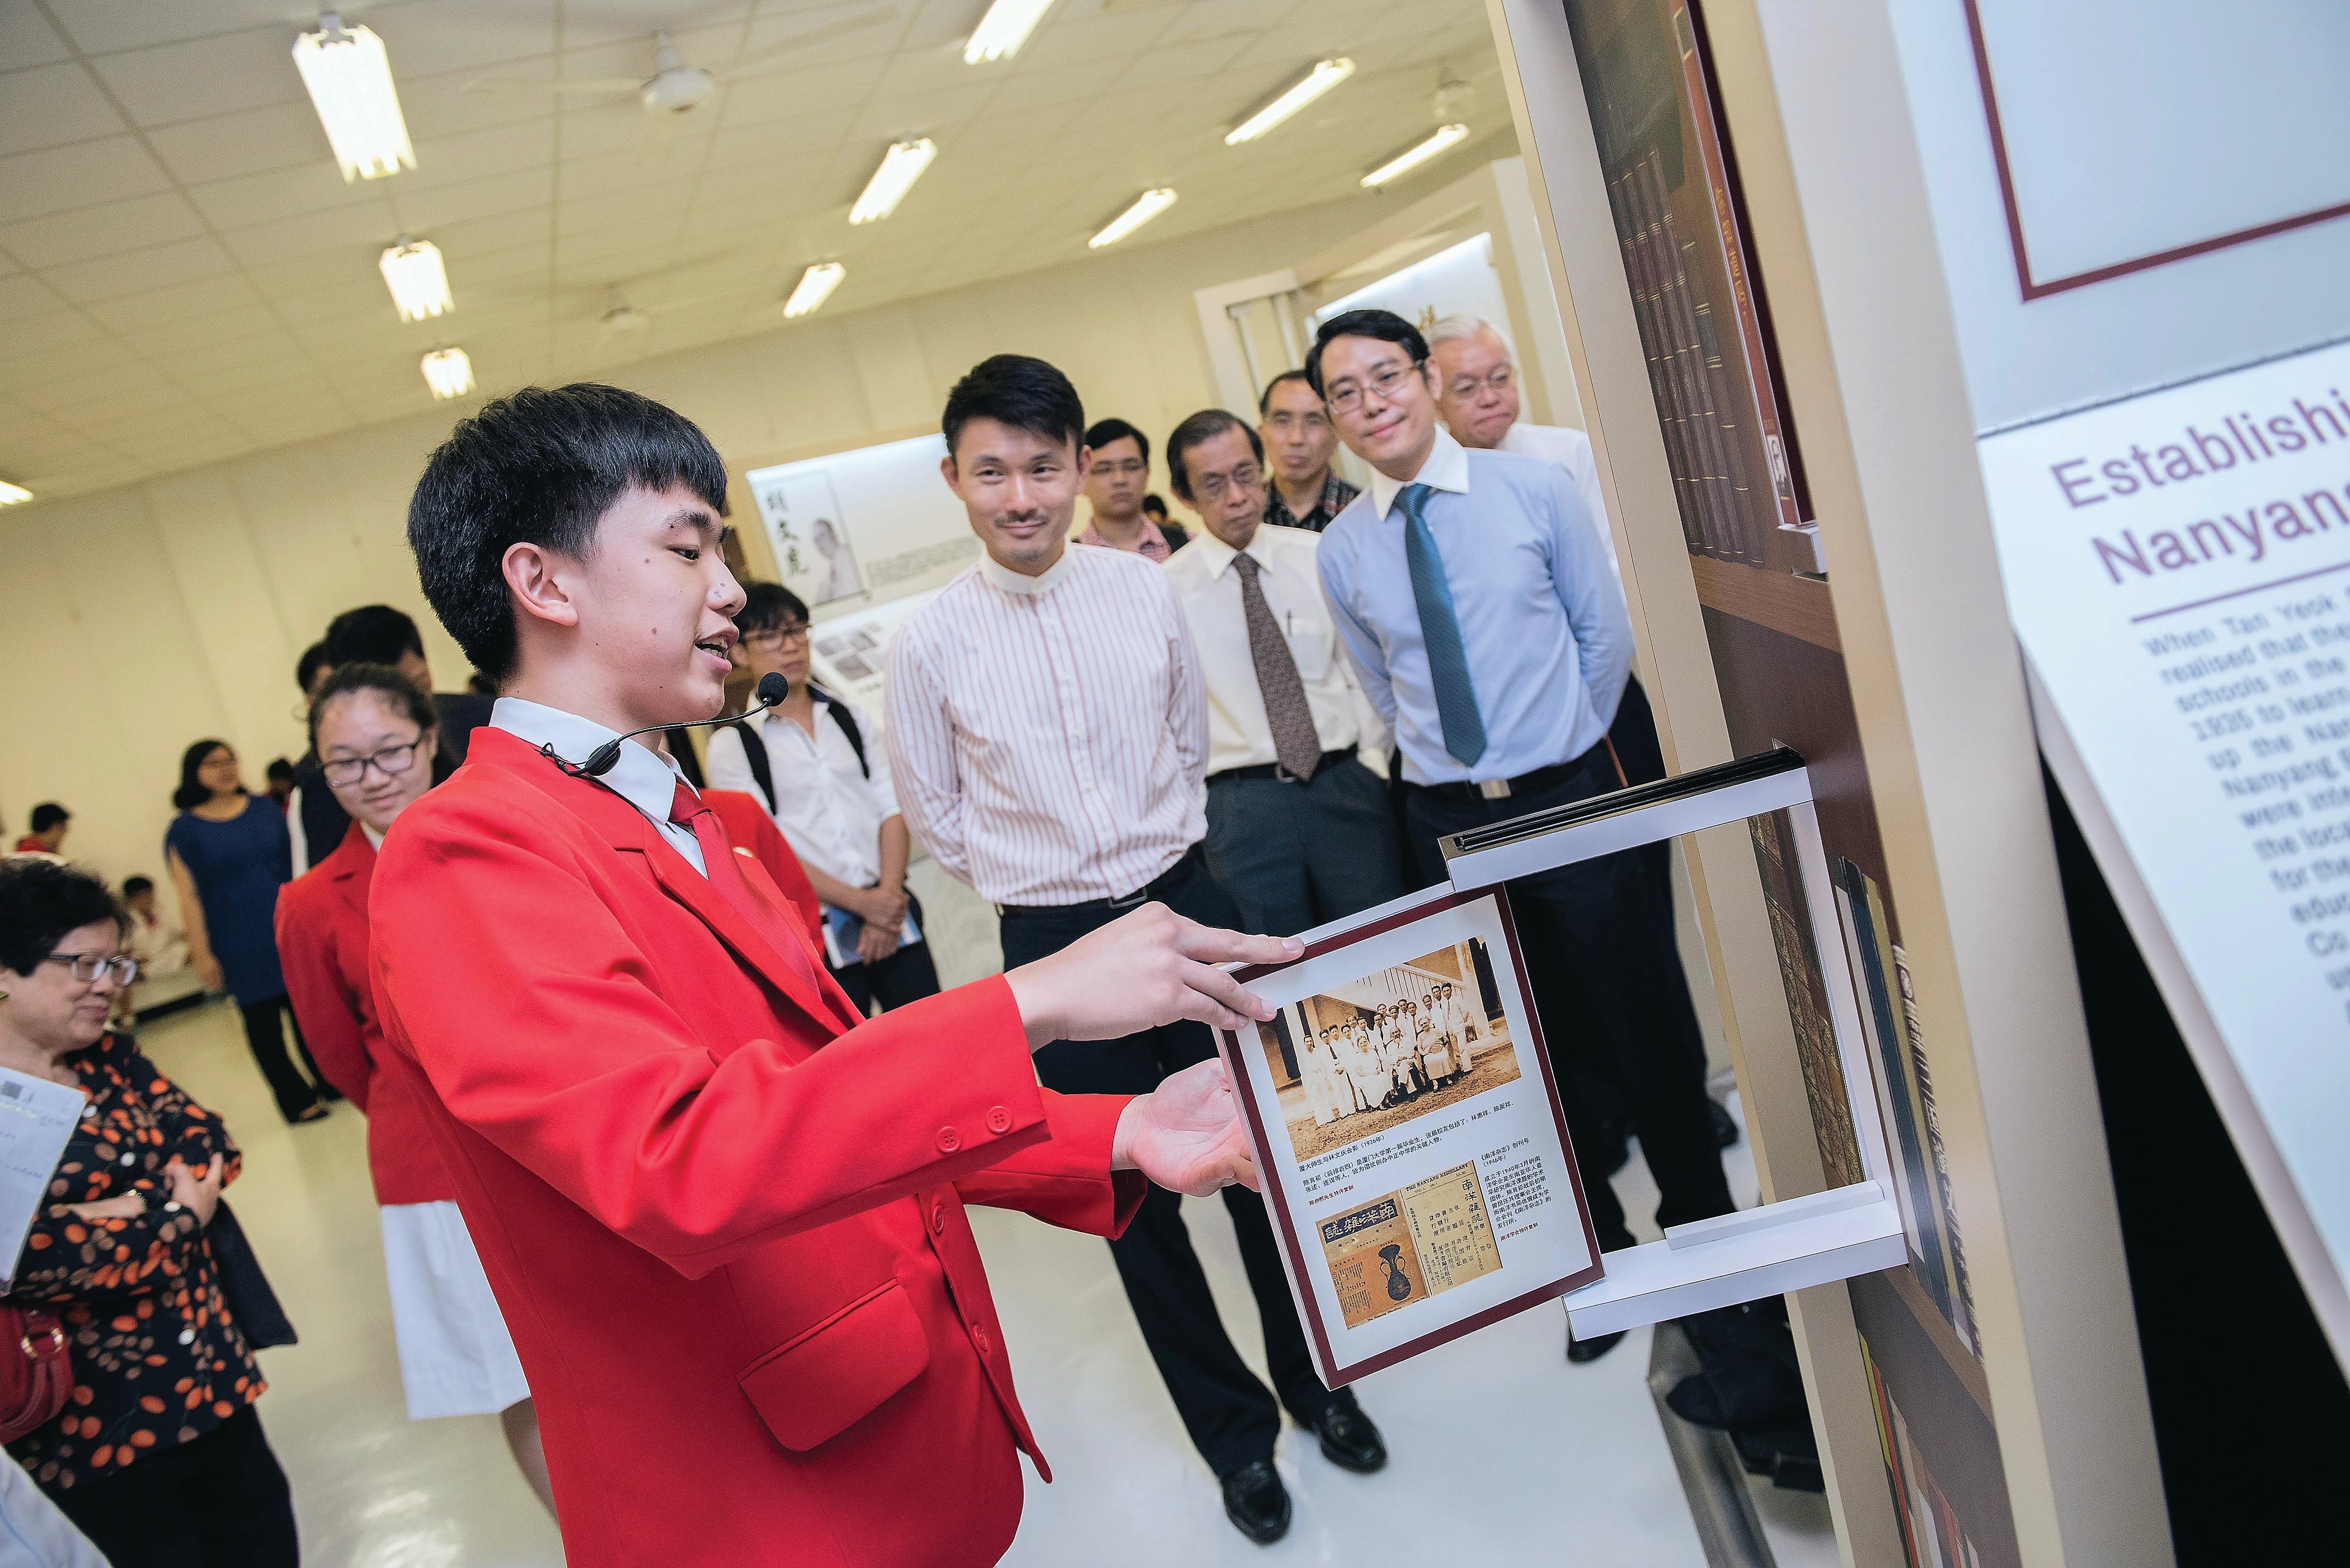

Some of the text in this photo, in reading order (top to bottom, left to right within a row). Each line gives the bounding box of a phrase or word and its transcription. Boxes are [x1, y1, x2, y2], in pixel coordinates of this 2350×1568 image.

[2092, 483, 2350, 585] Nanyan
[1480, 1137, 1530, 1161] 《南洋杂志》创刊号
[1416, 1175, 1439, 1187] NANYANG
[1439, 1163, 1468, 1178] MISCELLANY
[1483, 1155, 1540, 1182] 成立于1940年3月的南
[1485, 1162, 1542, 1189] 洋学会是东南亚华人最
[1487, 1169, 1544, 1195] 早研究南洋课题的学术
[1493, 1189, 1549, 1215] 而南洋书局也曾成为学
[1494, 1196, 1552, 1222] 会会刊《南洋杂志》的
